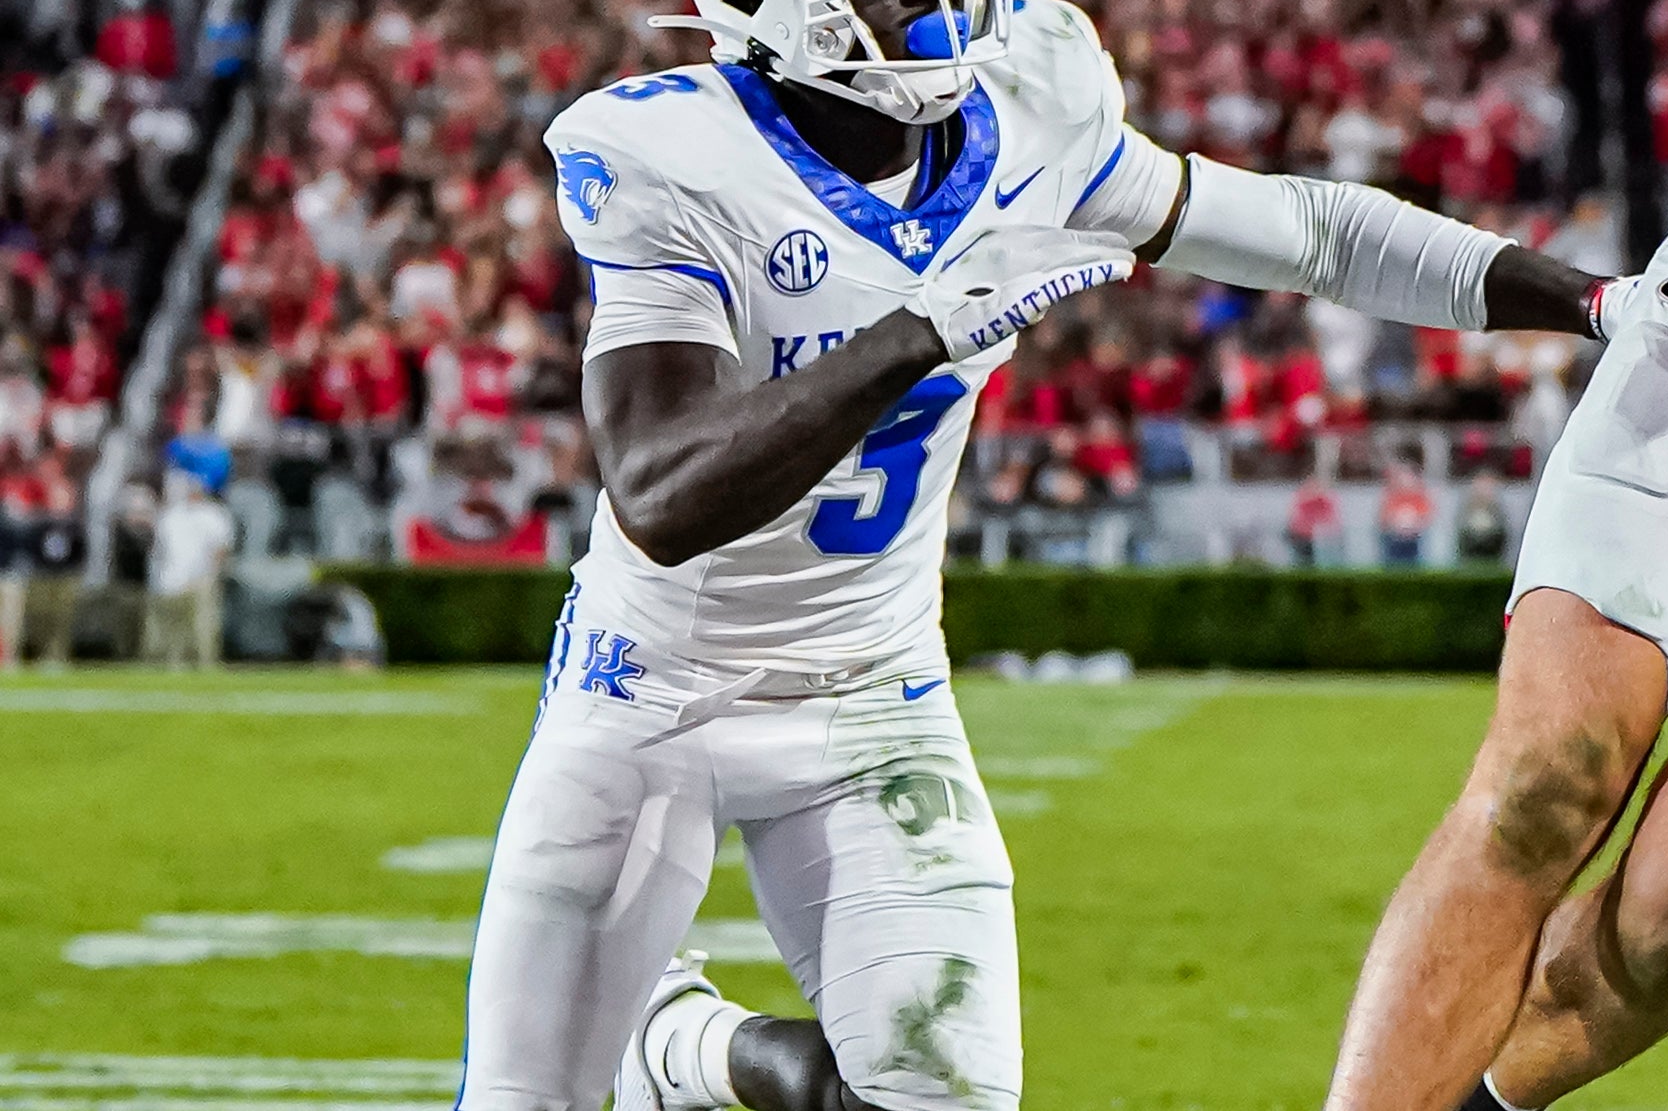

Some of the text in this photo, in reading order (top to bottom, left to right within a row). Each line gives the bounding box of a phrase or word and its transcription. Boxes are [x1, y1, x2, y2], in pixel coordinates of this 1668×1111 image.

[771, 231, 827, 290] SEC
[968, 263, 1113, 351] KENTUCKY
[803, 372, 969, 557] 3
